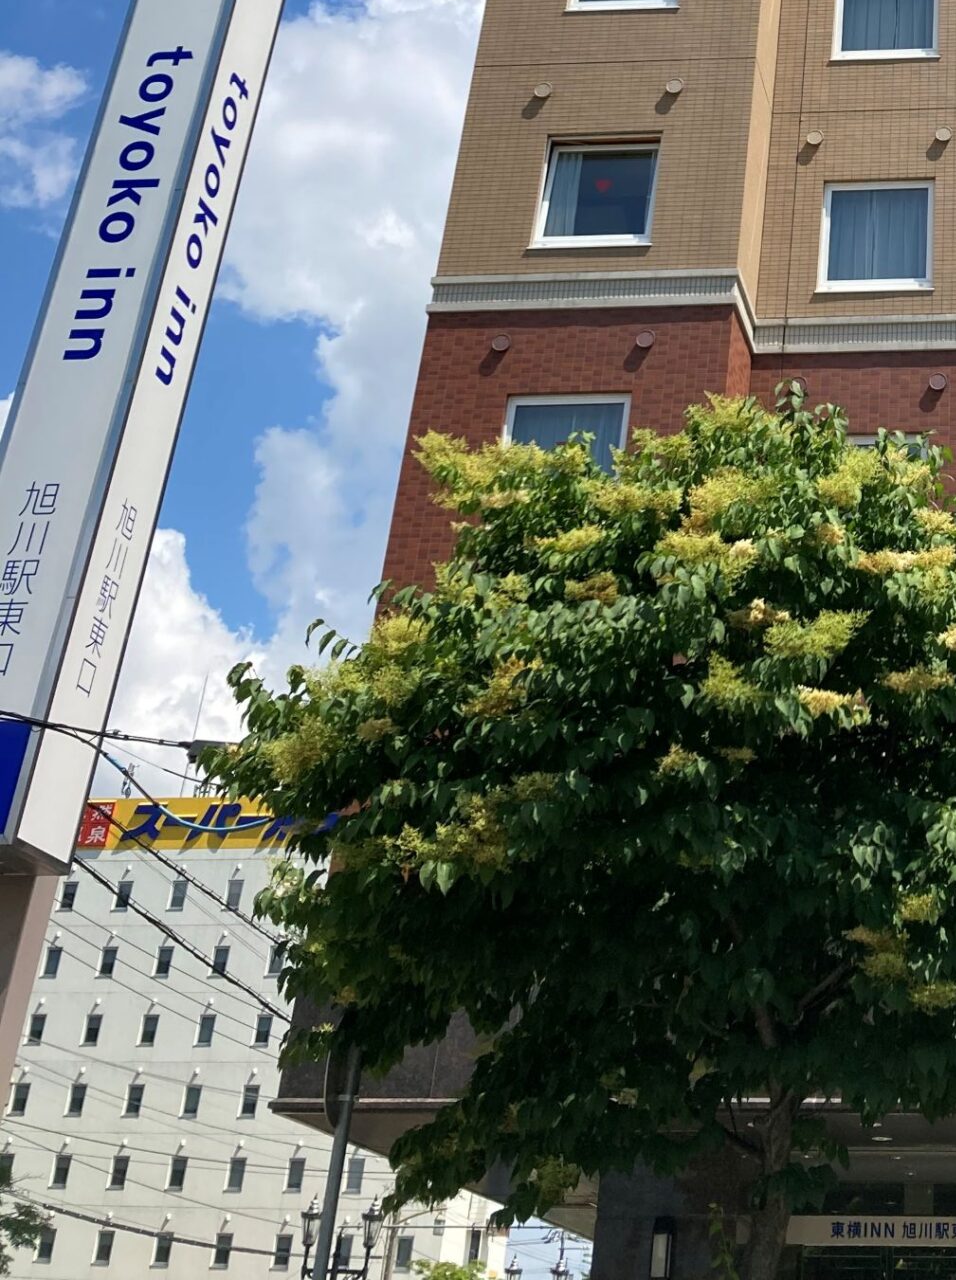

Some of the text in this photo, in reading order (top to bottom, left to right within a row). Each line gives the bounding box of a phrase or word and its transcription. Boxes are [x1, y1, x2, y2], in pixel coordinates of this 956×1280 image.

[62, 45, 194, 362] toyoko inn
[154, 71, 251, 387] toyoko inn
[76, 497, 138, 698] 旭川駅東口
[830, 1221, 895, 1239] 東横INN
